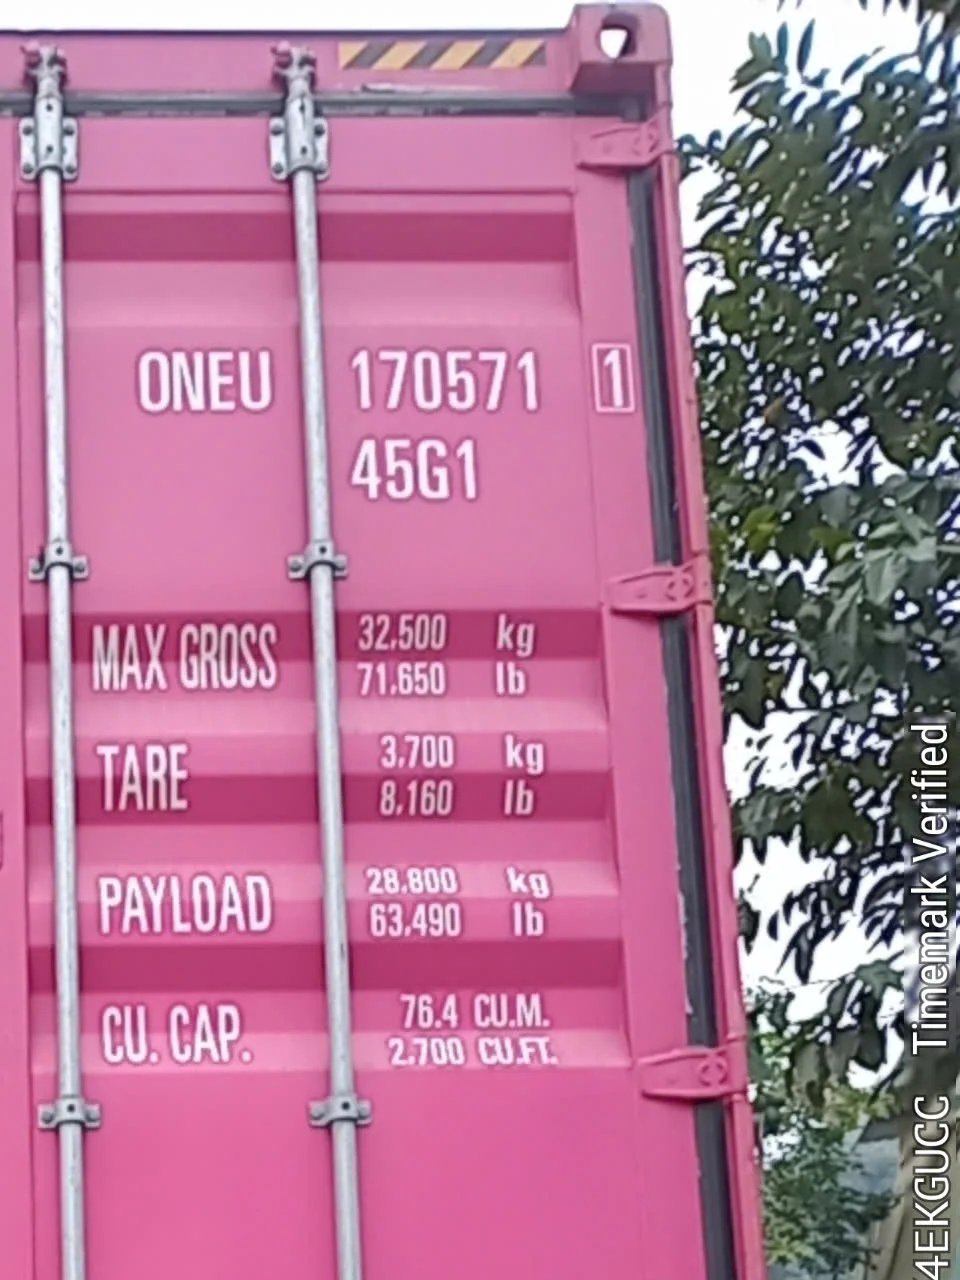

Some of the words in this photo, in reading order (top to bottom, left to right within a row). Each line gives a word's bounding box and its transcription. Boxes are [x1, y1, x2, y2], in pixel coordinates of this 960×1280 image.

[138, 350, 272, 412] ONEU
[350, 350, 539, 411] 170571
[602, 348, 625, 410] 1
[350, 438, 478, 499] 45G1
[93, 624, 168, 691] MAX
[180, 623, 277, 690] GROSS
[496, 612, 535, 659] kg
[495, 661, 526, 696] lb
[97, 743, 189, 811] TARE
[505, 734, 544, 776] kg
[503, 779, 534, 815] lb
[98, 875, 272, 934] PAYLOAD
[506, 866, 550, 899] kg
[512, 901, 545, 937] lb
[102, 1005, 159, 1064] CU.
[169, 1004, 253, 1063] CAP.
[400, 993, 459, 1029] 76.4
[474, 993, 551, 1028] CU.M.
